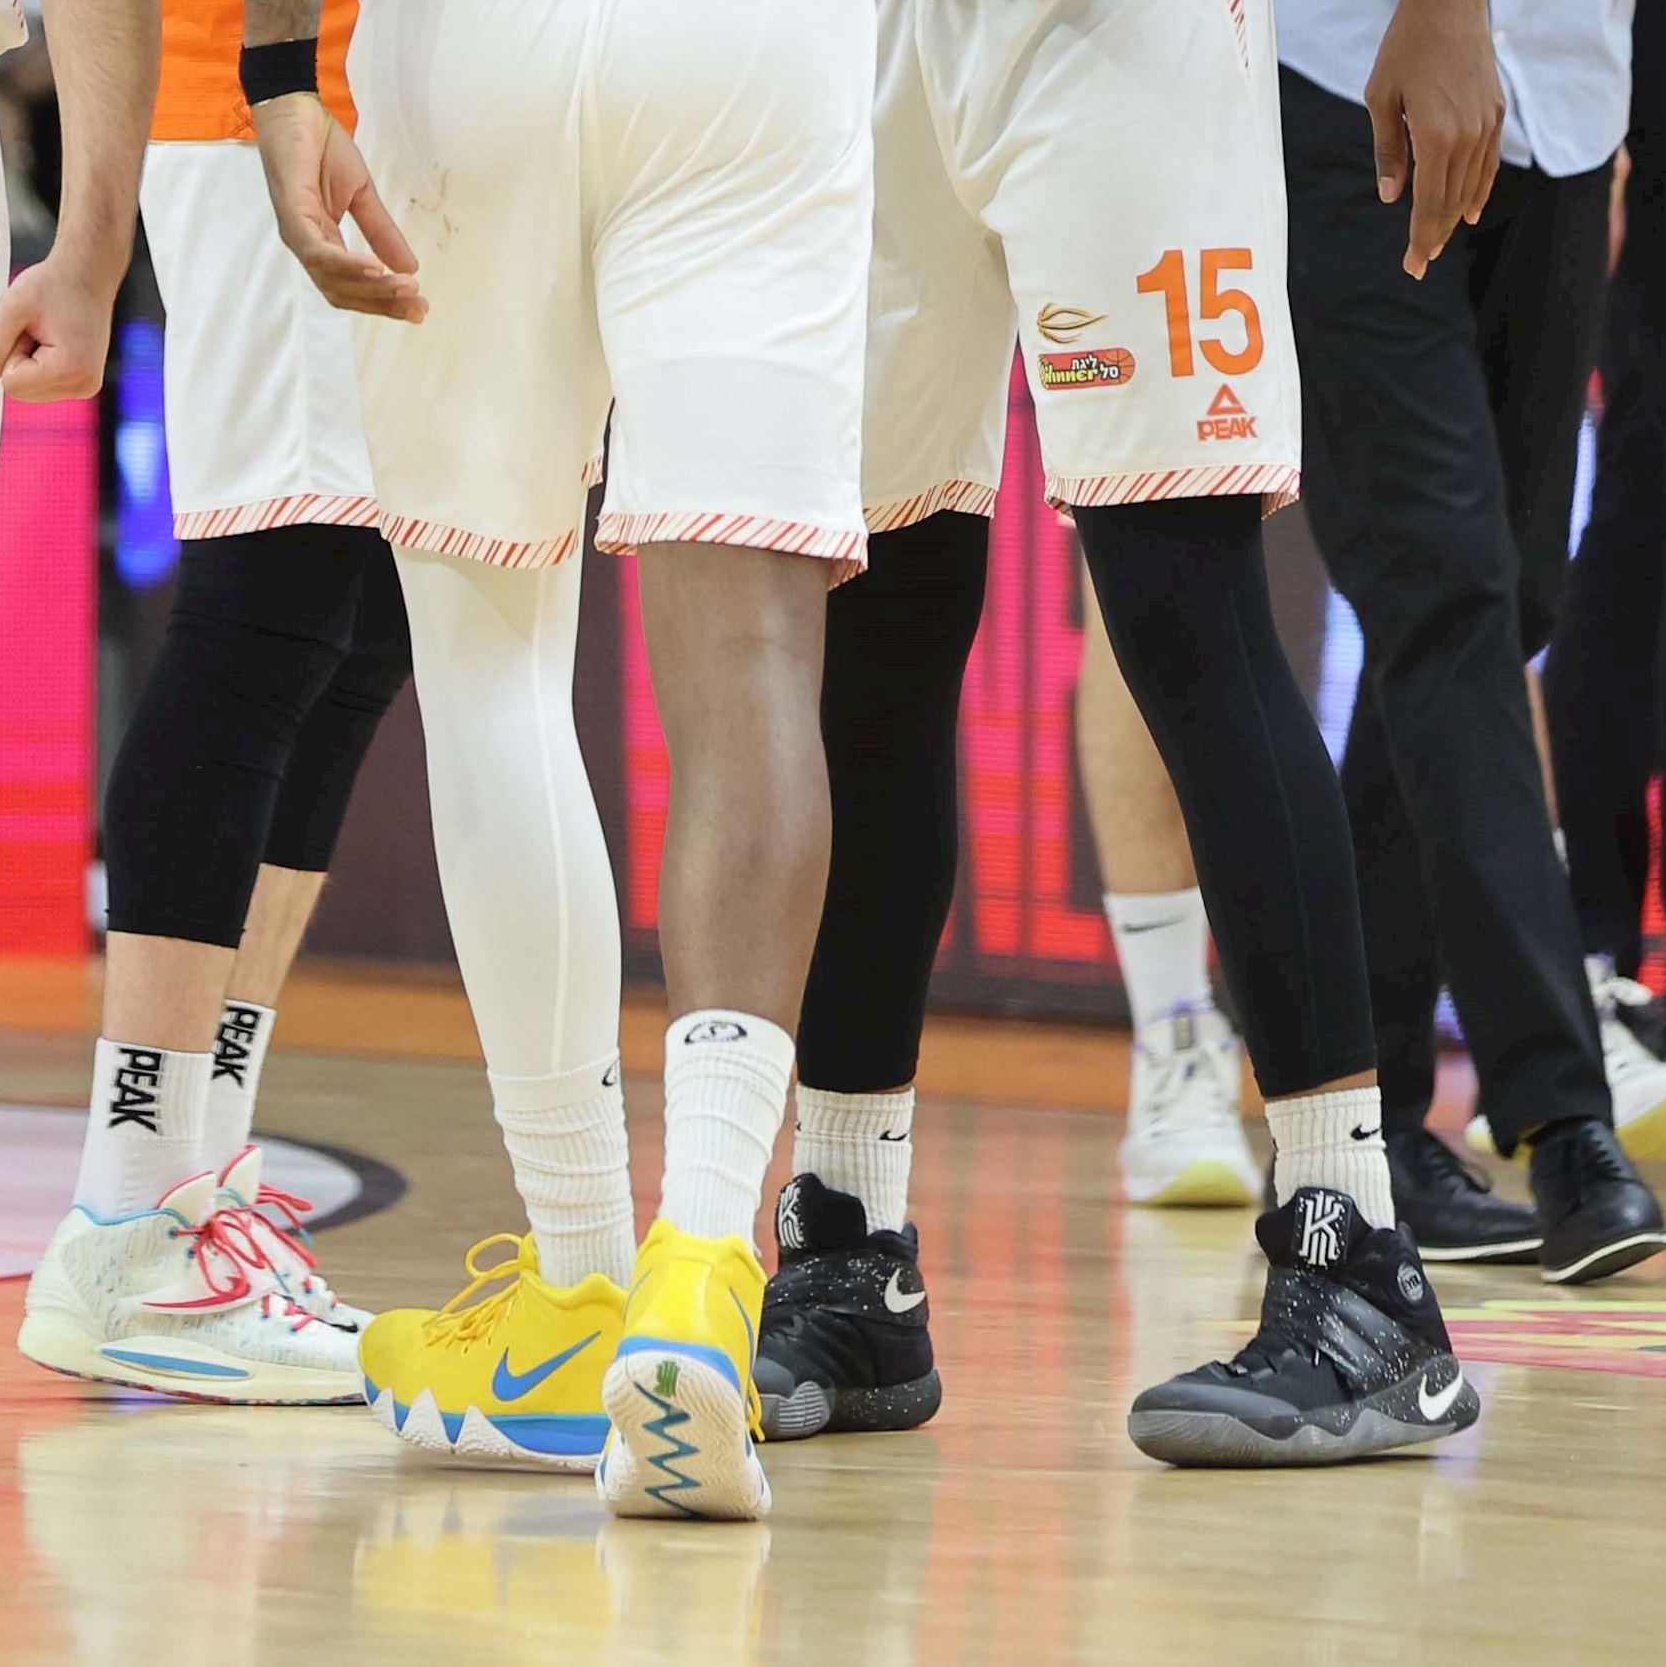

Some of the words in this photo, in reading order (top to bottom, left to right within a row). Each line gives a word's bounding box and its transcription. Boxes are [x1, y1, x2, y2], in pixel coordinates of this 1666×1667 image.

[1136, 247, 1265, 378] 15
[1071, 354, 1098, 370] ליגת
[1099, 363, 1119, 380] סל
[1196, 415, 1258, 442] PEAK
[212, 1005, 262, 1090] PEAK
[107, 1046, 164, 1136] PEAK
